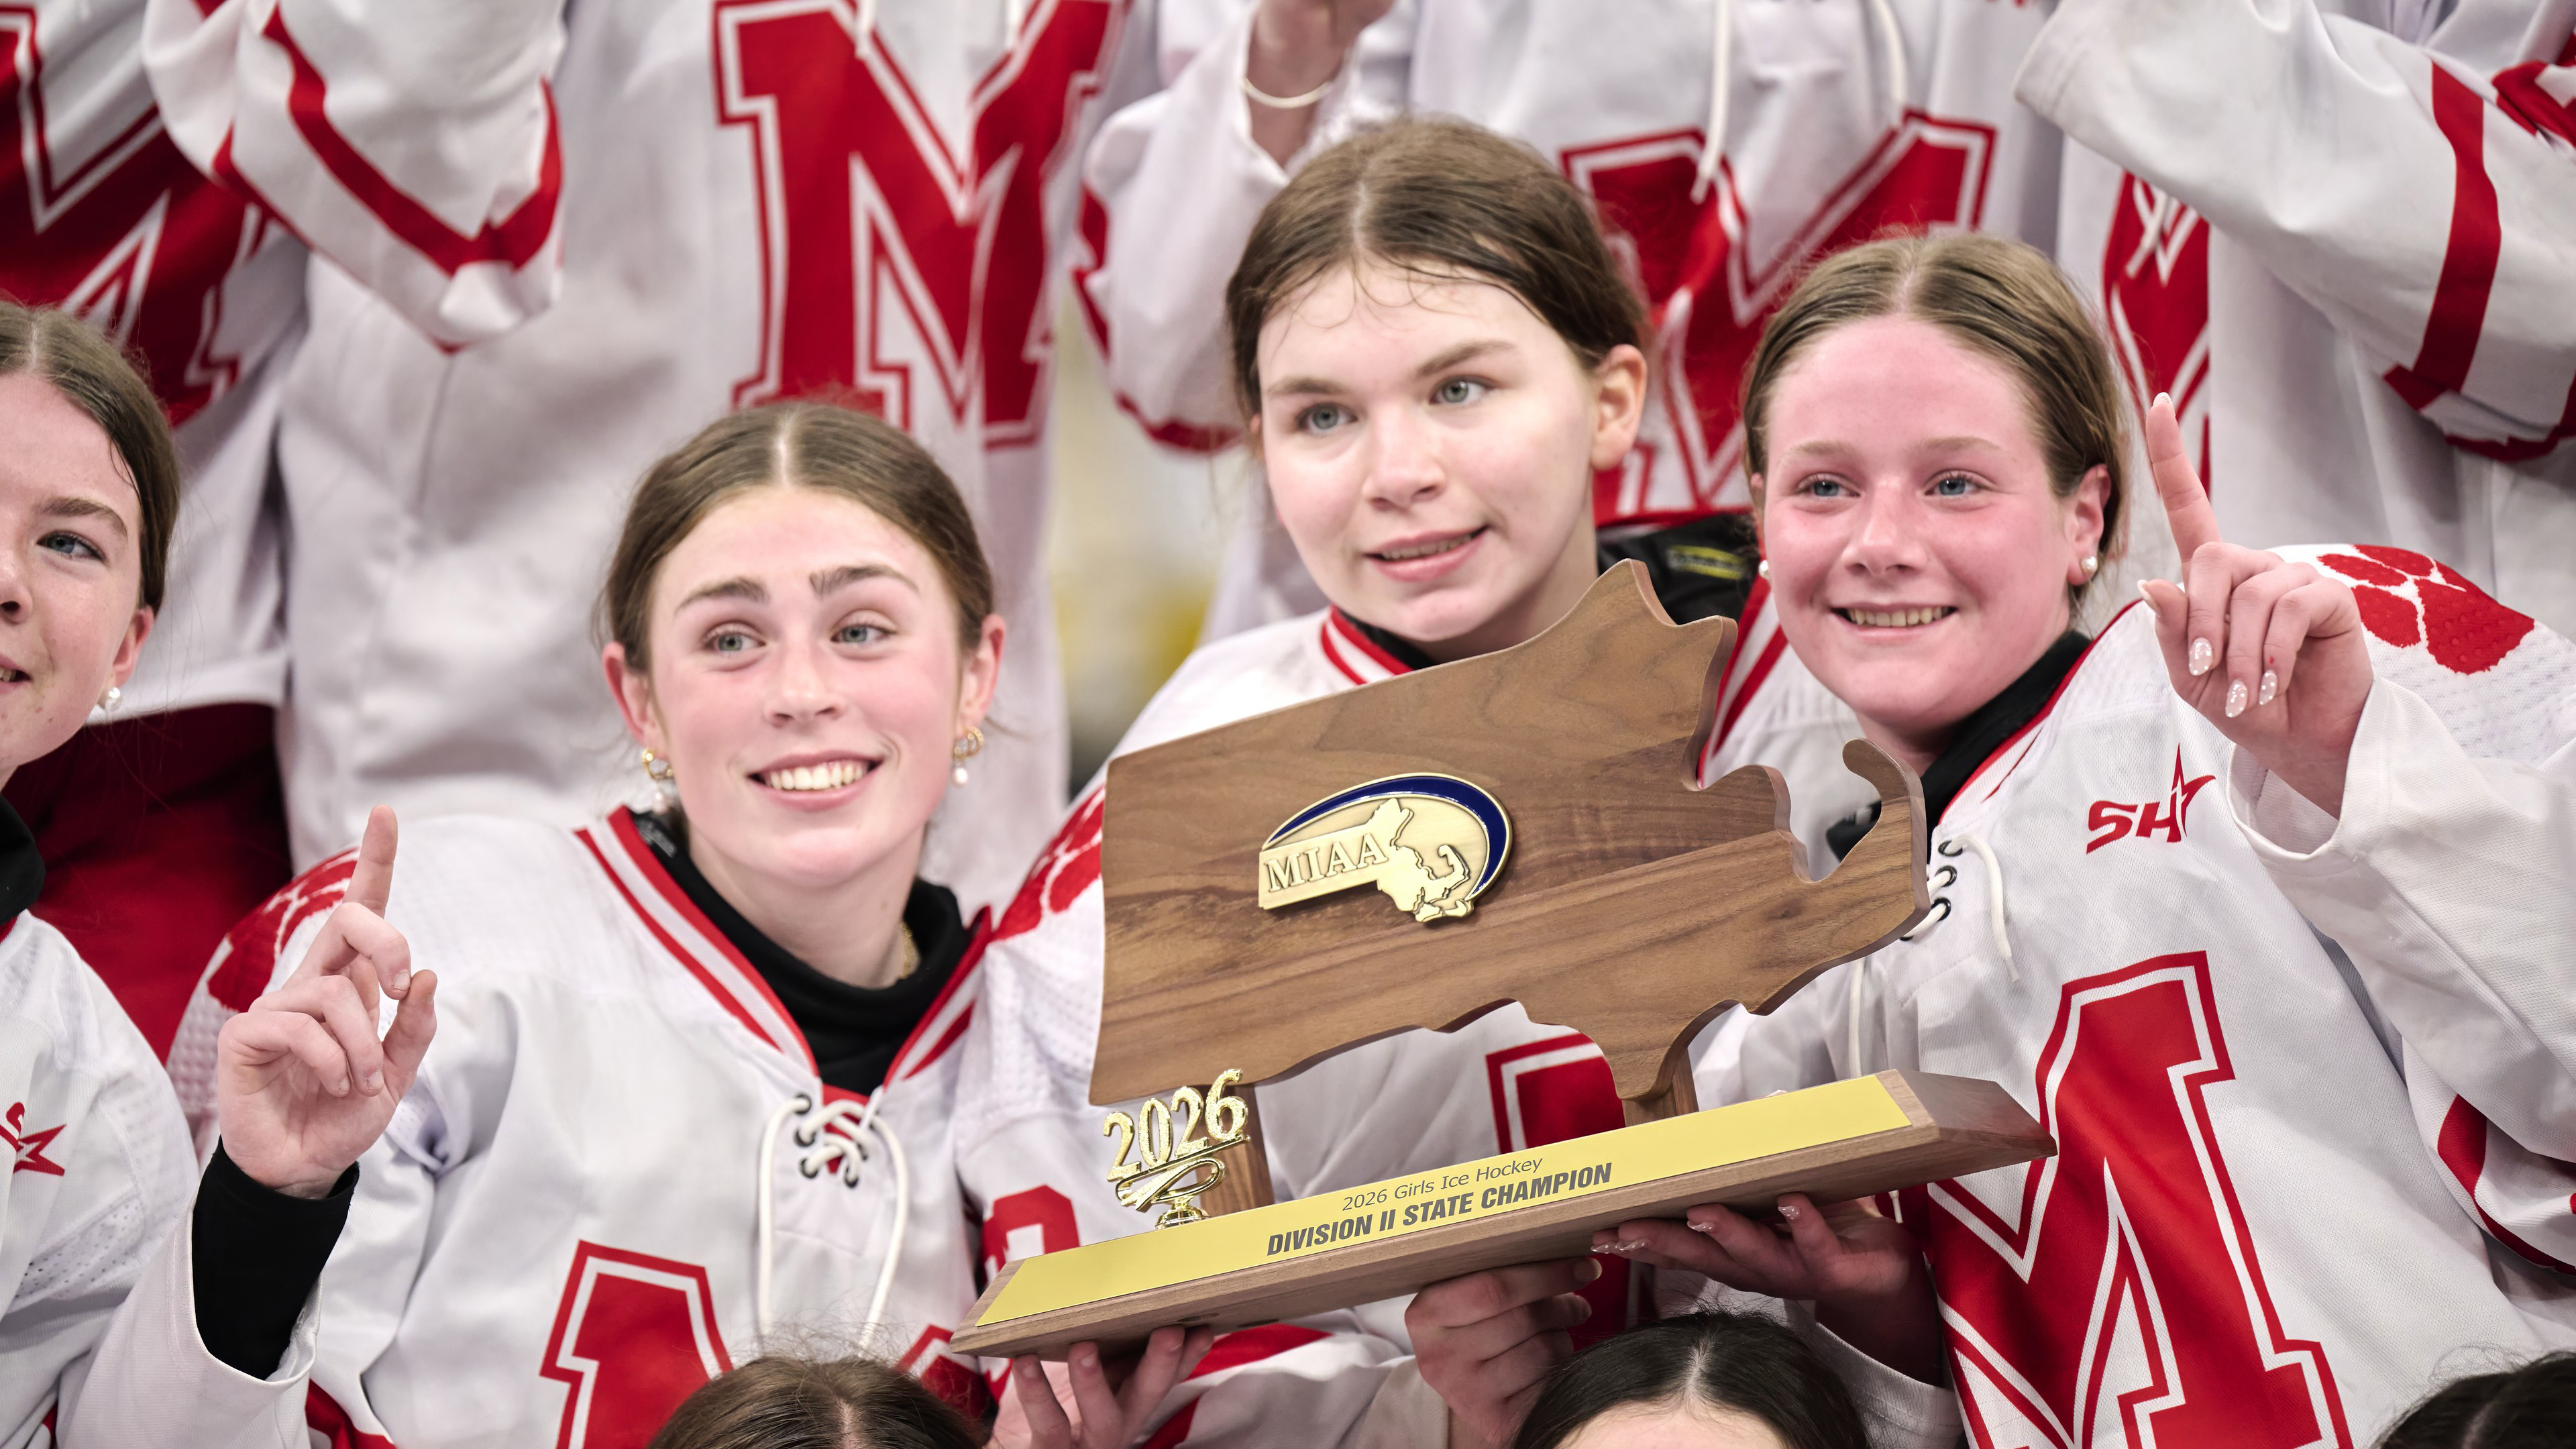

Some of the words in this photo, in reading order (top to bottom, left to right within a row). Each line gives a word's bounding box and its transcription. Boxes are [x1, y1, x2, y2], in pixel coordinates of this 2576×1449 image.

[711, 0, 1130, 451] M
[1263, 832, 1389, 893] MIAA
[1103, 1068, 1249, 1183] 2026
[1267, 1214, 1373, 1256] DIVISION
[1379, 1208, 1397, 1232] II
[1402, 1191, 1474, 1226] STATE
[1481, 1162, 1612, 1209] CHAMPION
[1342, 1185, 1387, 1212] 2026
[1394, 1180, 1435, 1199] Girls
[1440, 1174, 1469, 1190] Ice
[1476, 1158, 1544, 1182] Hockey
